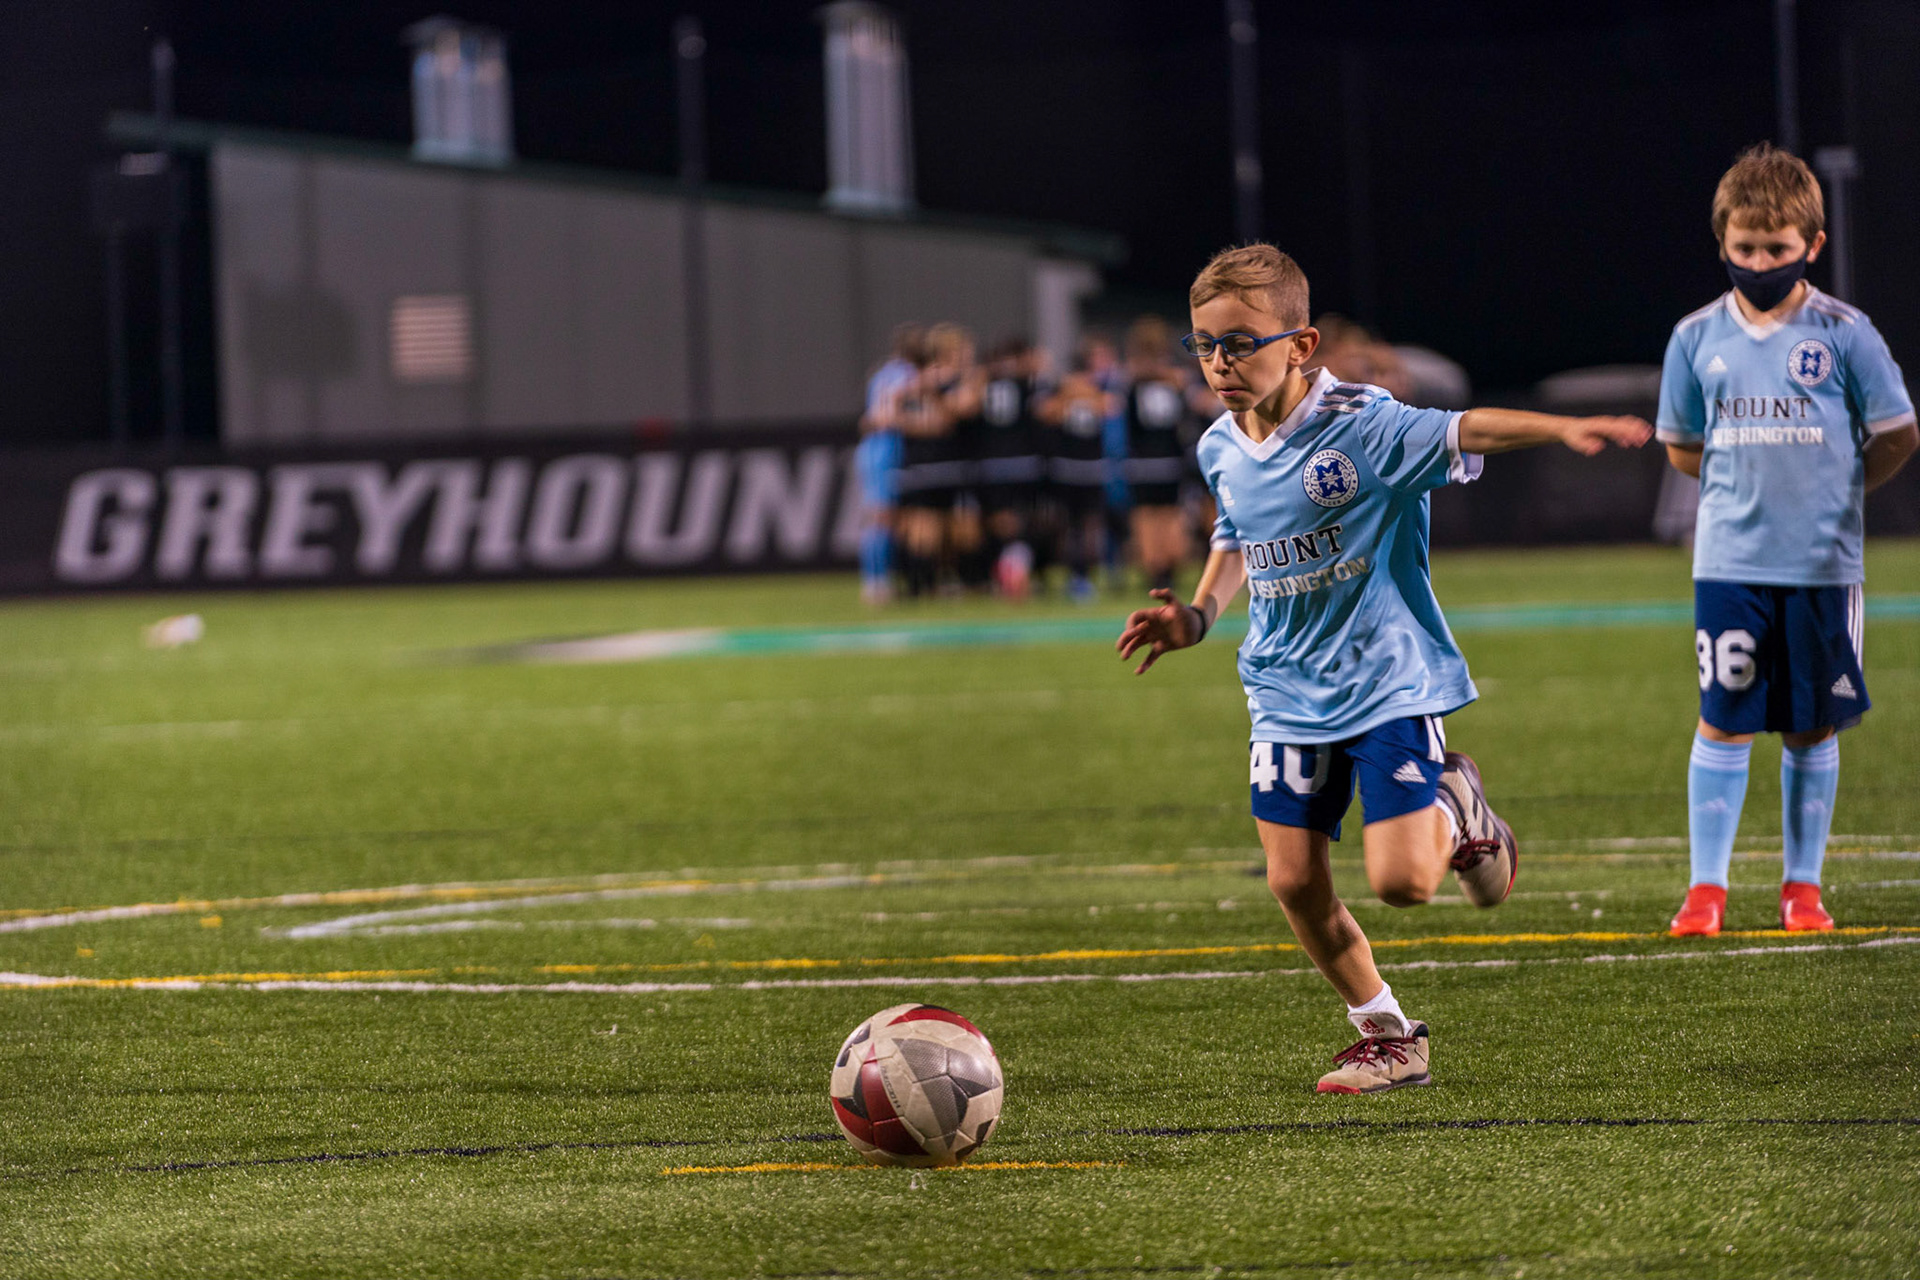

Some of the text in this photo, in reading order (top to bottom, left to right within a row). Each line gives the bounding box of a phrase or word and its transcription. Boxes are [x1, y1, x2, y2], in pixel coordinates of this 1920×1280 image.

[1315, 451, 1355, 475] WASHINGTON
[1313, 496, 1342, 506] SOCCER
[1250, 741, 1331, 795] 40
